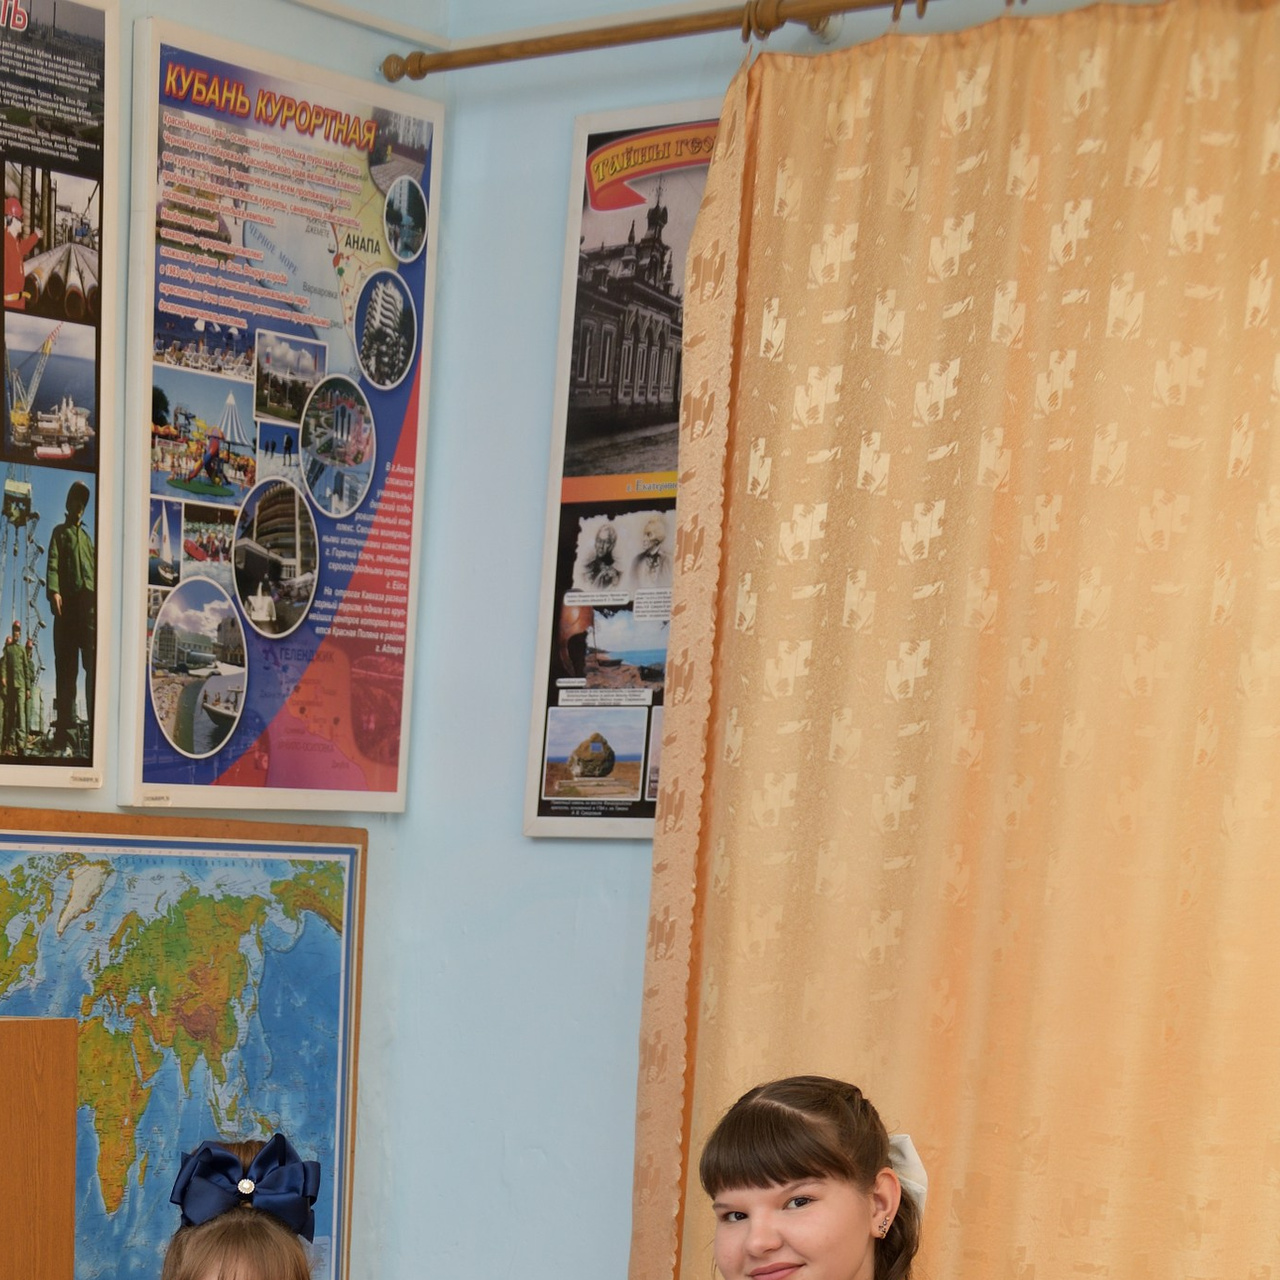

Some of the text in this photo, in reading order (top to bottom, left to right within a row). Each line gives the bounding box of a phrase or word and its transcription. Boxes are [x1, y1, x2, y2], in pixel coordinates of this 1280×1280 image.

[164, 62, 252, 116] КУБАНЬ
[254, 90, 379, 151] КУРОРТНАЯ
[594, 135, 716, 182] ТАЙНЫ ГЕО
[247, 222, 300, 277] ЧЕРНОЕ МОРЕ
[344, 231, 380, 256] АНАПА
